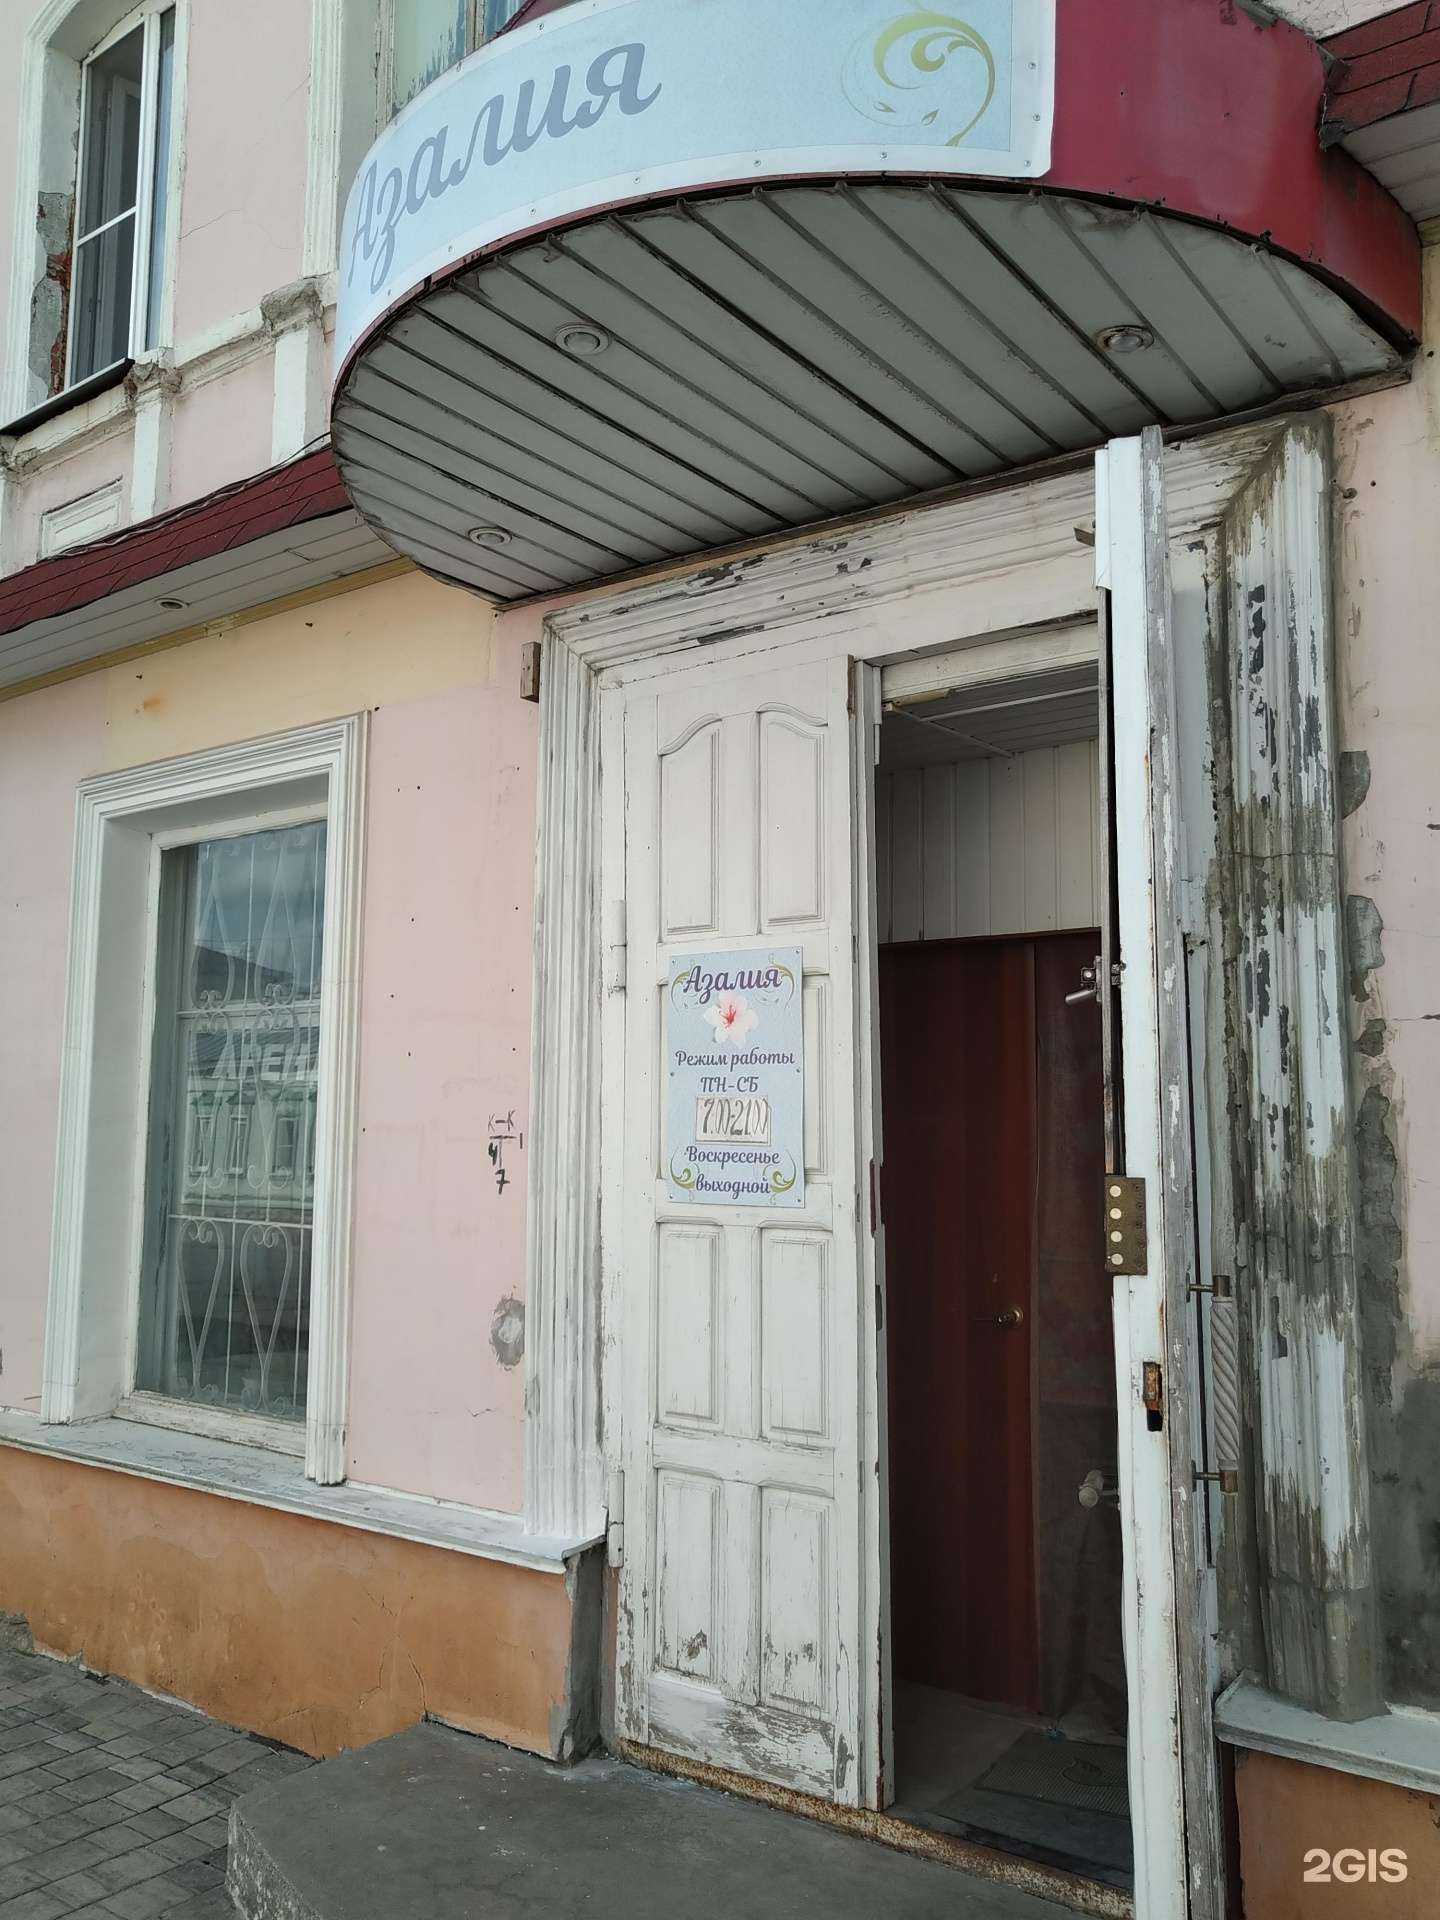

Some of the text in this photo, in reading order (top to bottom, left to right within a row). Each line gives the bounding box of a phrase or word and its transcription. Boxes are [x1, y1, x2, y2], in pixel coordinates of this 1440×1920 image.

[347, 42, 663, 296] Азалия
[683, 965, 783, 1005] Азалия
[675, 1047, 796, 1072] Режим работы
[700, 1076, 759, 1093] ПН-СБ
[686, 1145, 782, 1170] Воскресенье
[695, 1173, 772, 1200] выходной
